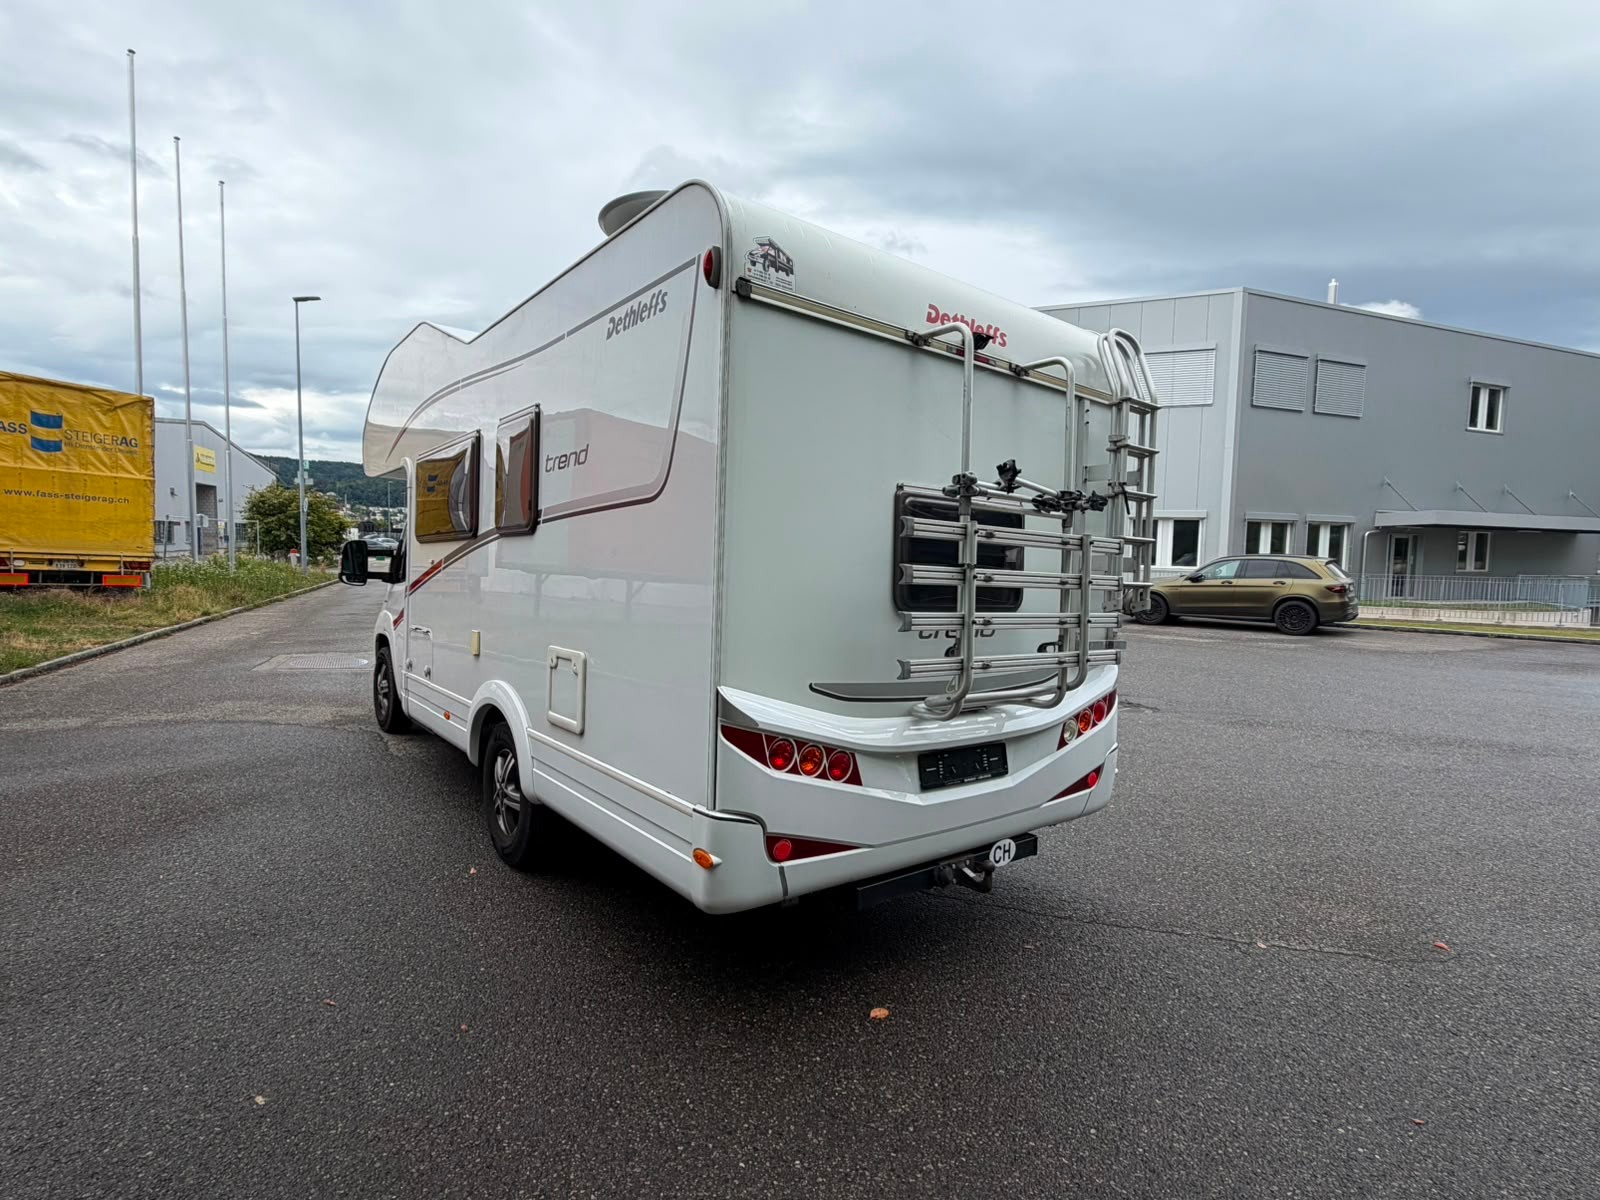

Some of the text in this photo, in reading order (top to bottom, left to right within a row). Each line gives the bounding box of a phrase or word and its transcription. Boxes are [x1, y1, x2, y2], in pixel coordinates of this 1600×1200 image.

[606, 289, 668, 340] Dethleffs
[545, 443, 589, 473] trend
[3, 488, 130, 504] www.fass-steigerag.ch
[993, 842, 1011, 864] CH
